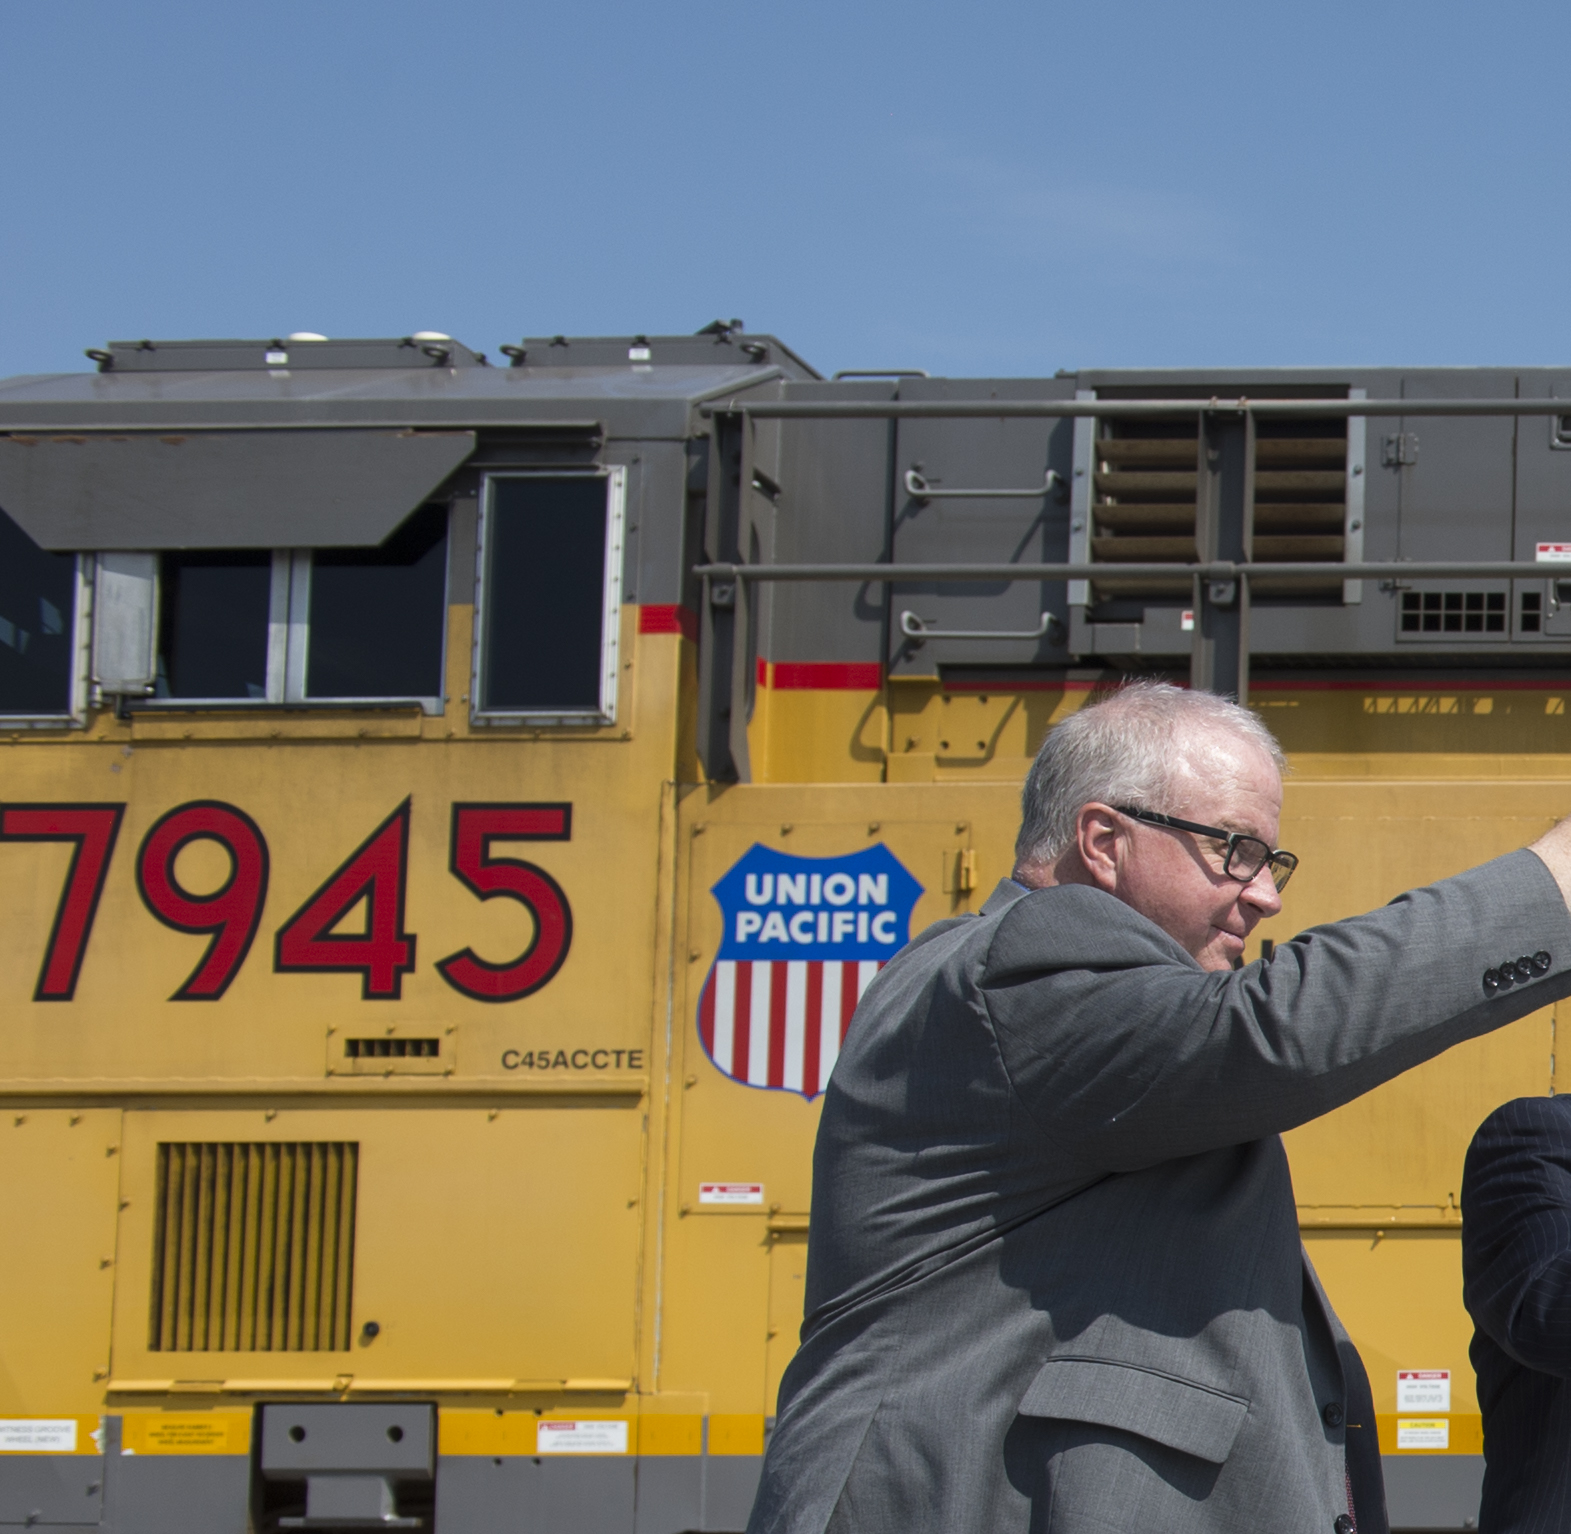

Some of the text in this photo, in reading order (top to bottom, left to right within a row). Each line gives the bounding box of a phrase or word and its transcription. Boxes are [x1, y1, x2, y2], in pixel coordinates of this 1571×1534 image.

[0, 793, 573, 1002] 7945
[745, 872, 888, 906] UNION
[735, 911, 897, 944] PACIFIC
[501, 1048, 644, 1070] C45ACCTE
